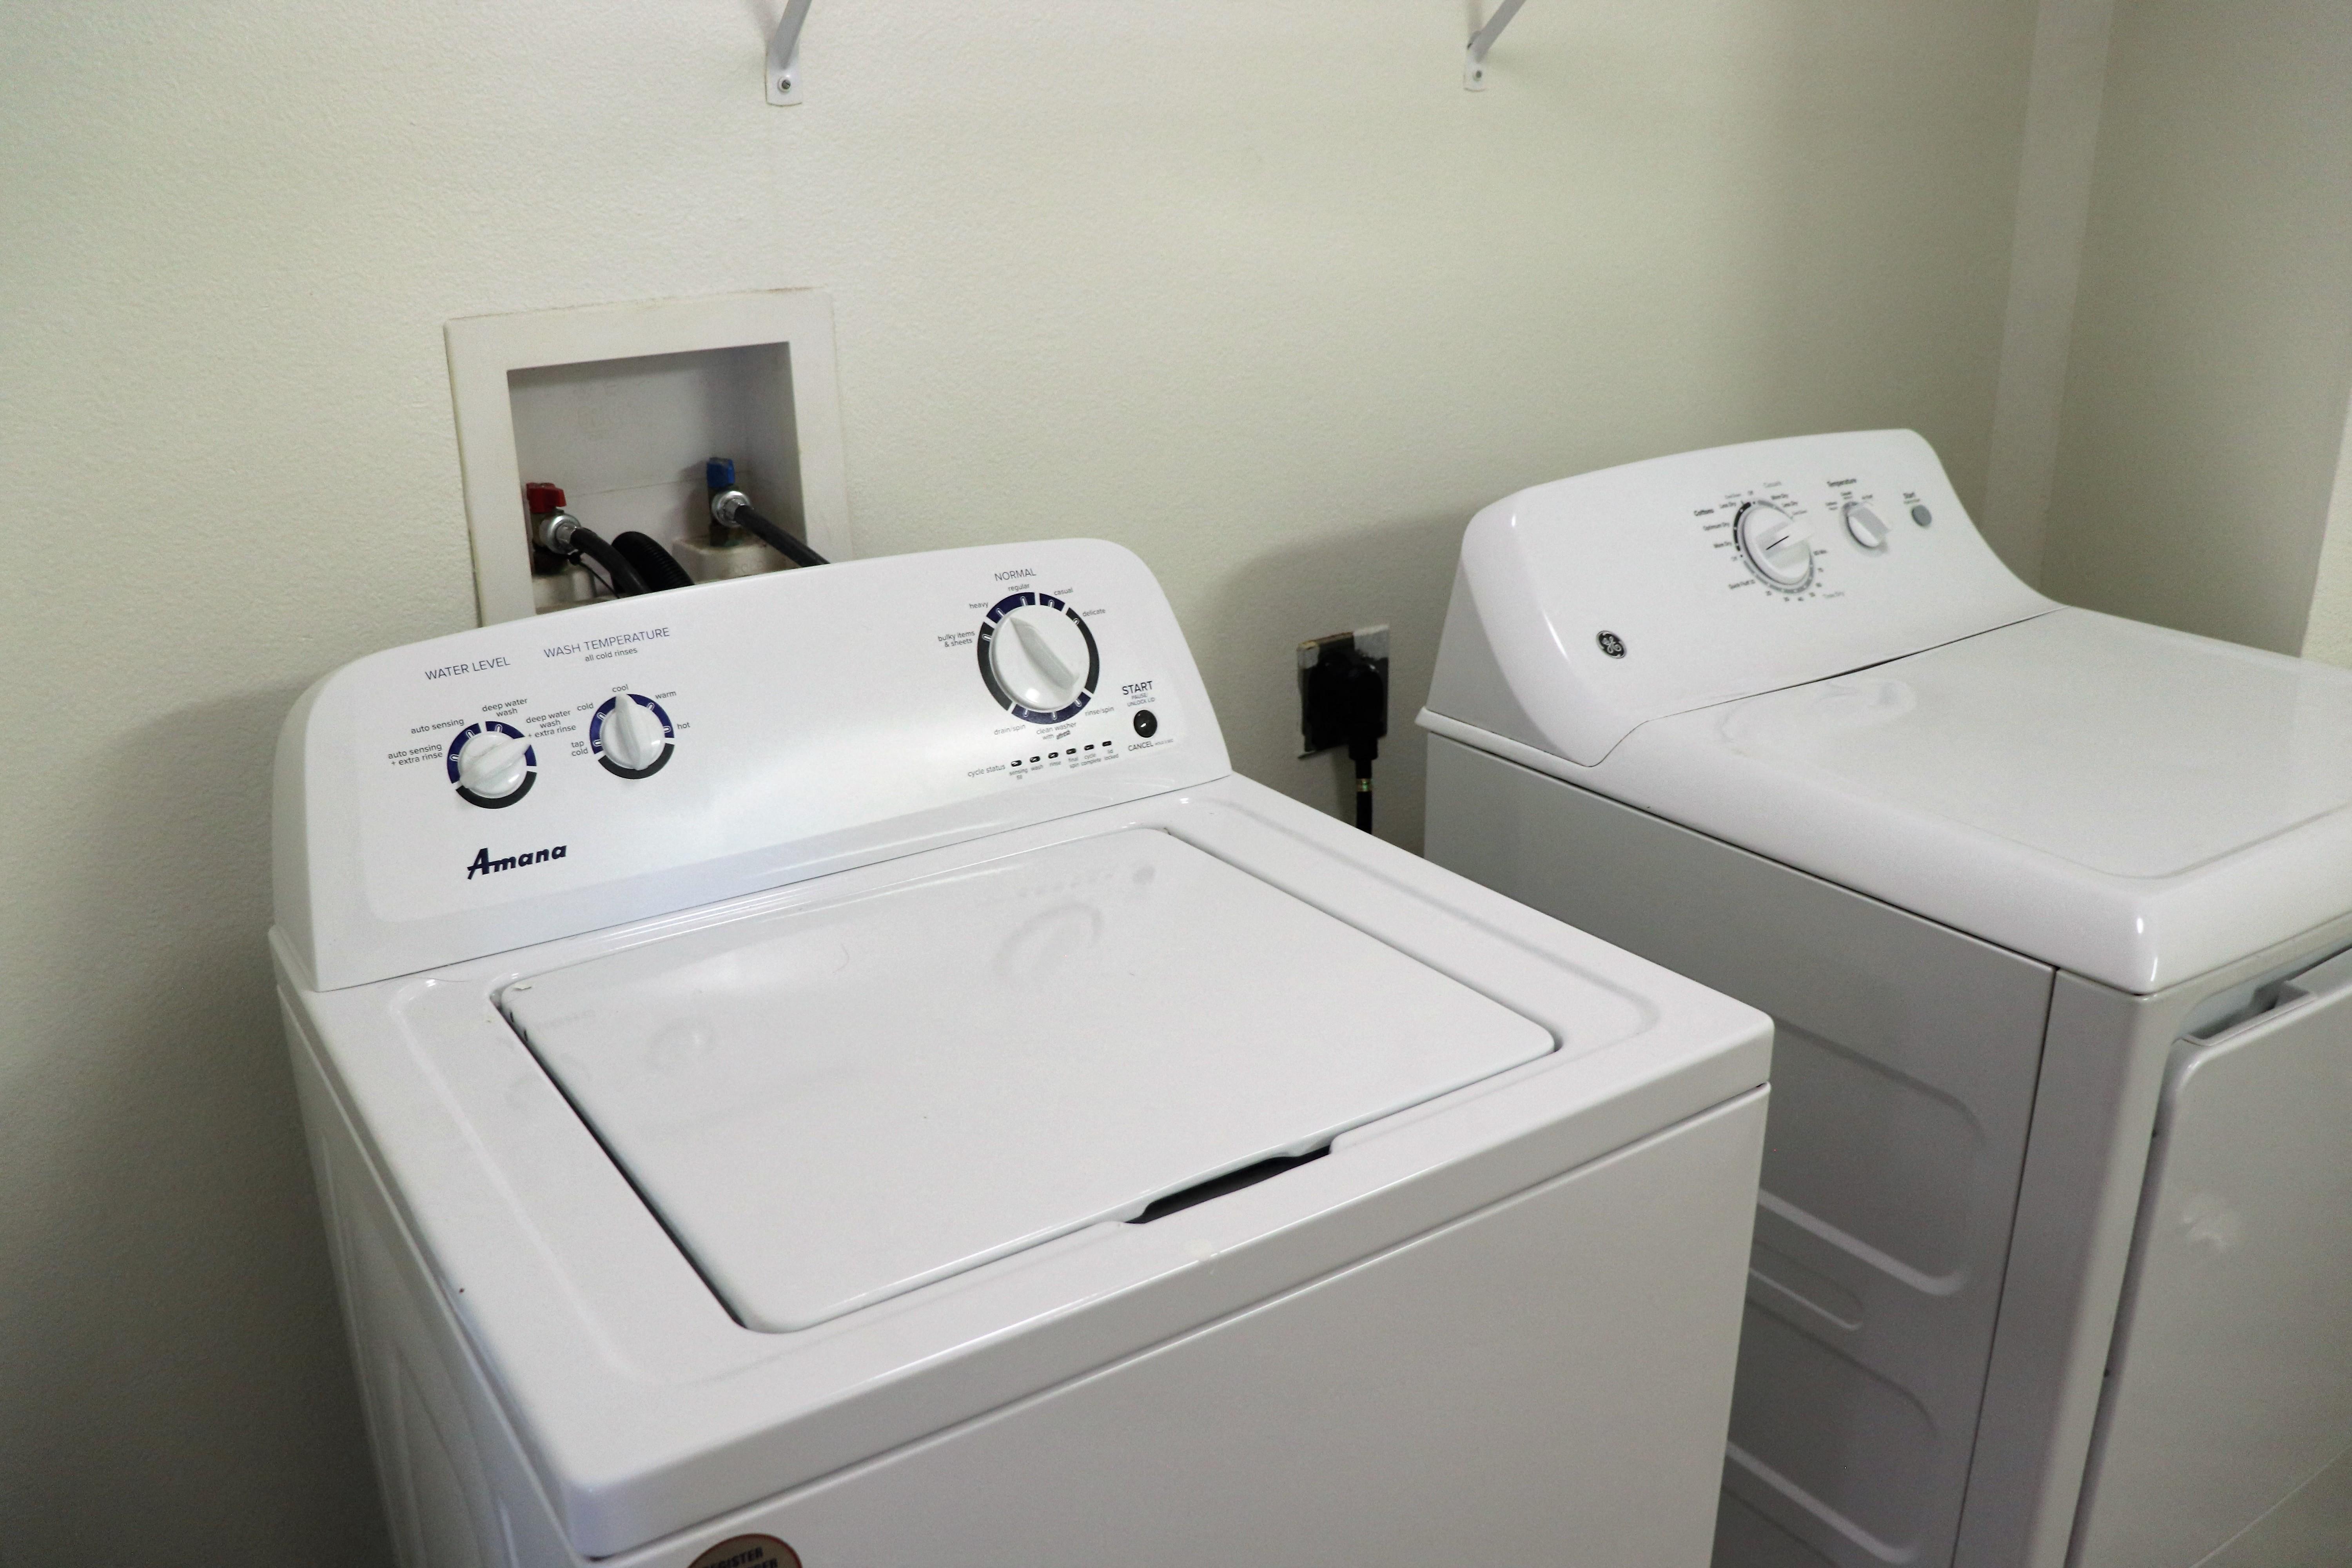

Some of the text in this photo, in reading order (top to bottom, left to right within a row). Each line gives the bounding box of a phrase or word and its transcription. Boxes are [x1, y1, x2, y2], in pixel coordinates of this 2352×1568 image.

[995, 568, 1037, 581] NORMAL
[1008, 583, 1030, 592] regular
[1054, 587, 1073, 595] casual
[1082, 608, 1106, 617] delicate
[544, 627, 670, 658] WASH TEMPERATURE
[938, 630, 975, 642] bulky items
[951, 638, 973, 646] sheets
[596, 651, 612, 660] cold
[615, 647, 638, 657] rinses
[425, 657, 511, 681] WATER LEVEL
[612, 684, 629, 692] cool
[1122, 681, 1152, 695] START
[655, 691, 677, 699] warm
[482, 698, 528, 713] deep water
[577, 702, 594, 711] cold
[496, 708, 518, 717] wash
[526, 710, 571, 724] deep water
[411, 719, 465, 735] auto sensing
[539, 719, 561, 729] wash
[1036, 722, 1076, 735] clean washer
[534, 728, 555, 738] extra
[557, 724, 577, 733] rinse
[388, 744, 443, 759] auto sensing
[572, 748, 588, 757] cold
[1128, 741, 1153, 751] CANCEL
[398, 756, 419, 766] extra
[421, 751, 443, 761] rinse
[1081, 757, 1102, 766] complete
[967, 764, 1005, 777] cycle status
[467, 845, 567, 880] Amana
